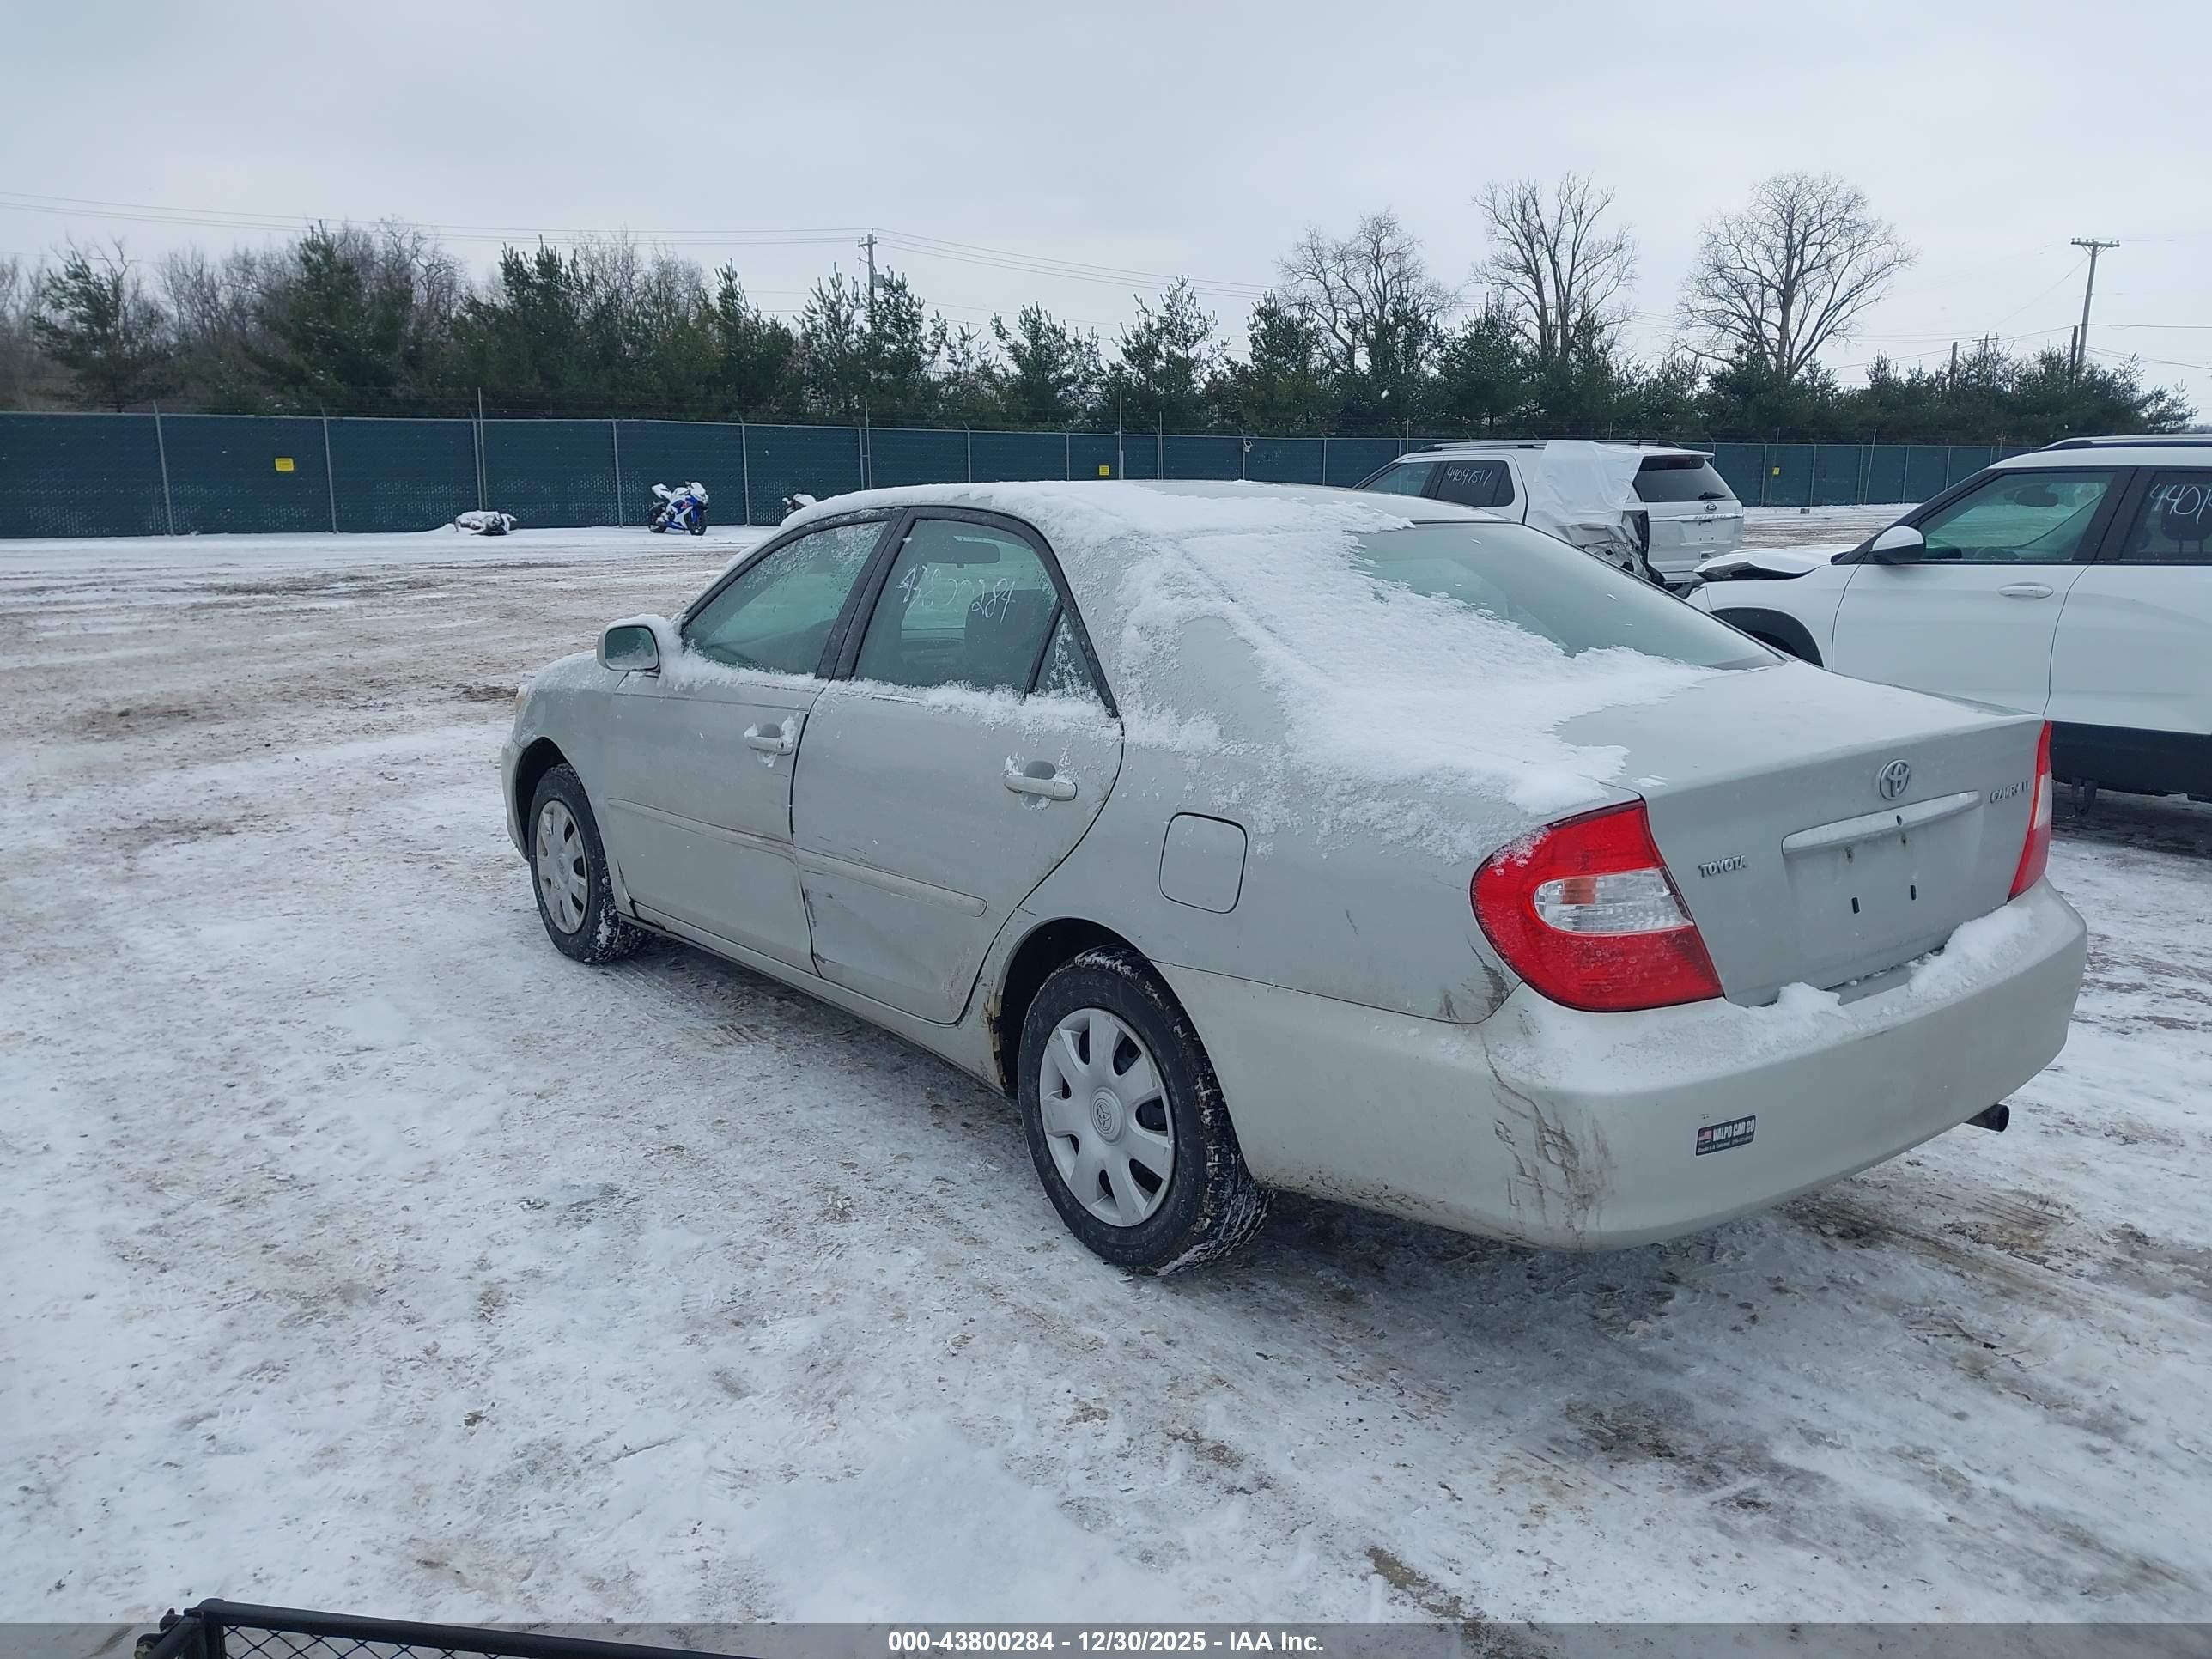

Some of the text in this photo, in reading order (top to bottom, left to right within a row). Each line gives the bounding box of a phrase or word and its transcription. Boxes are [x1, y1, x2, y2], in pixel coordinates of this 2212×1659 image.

[1698, 854, 1747, 878] TOYOTA
[1712, 1125, 1733, 1142] VALPO
[1733, 1121, 1746, 1137] CAR
